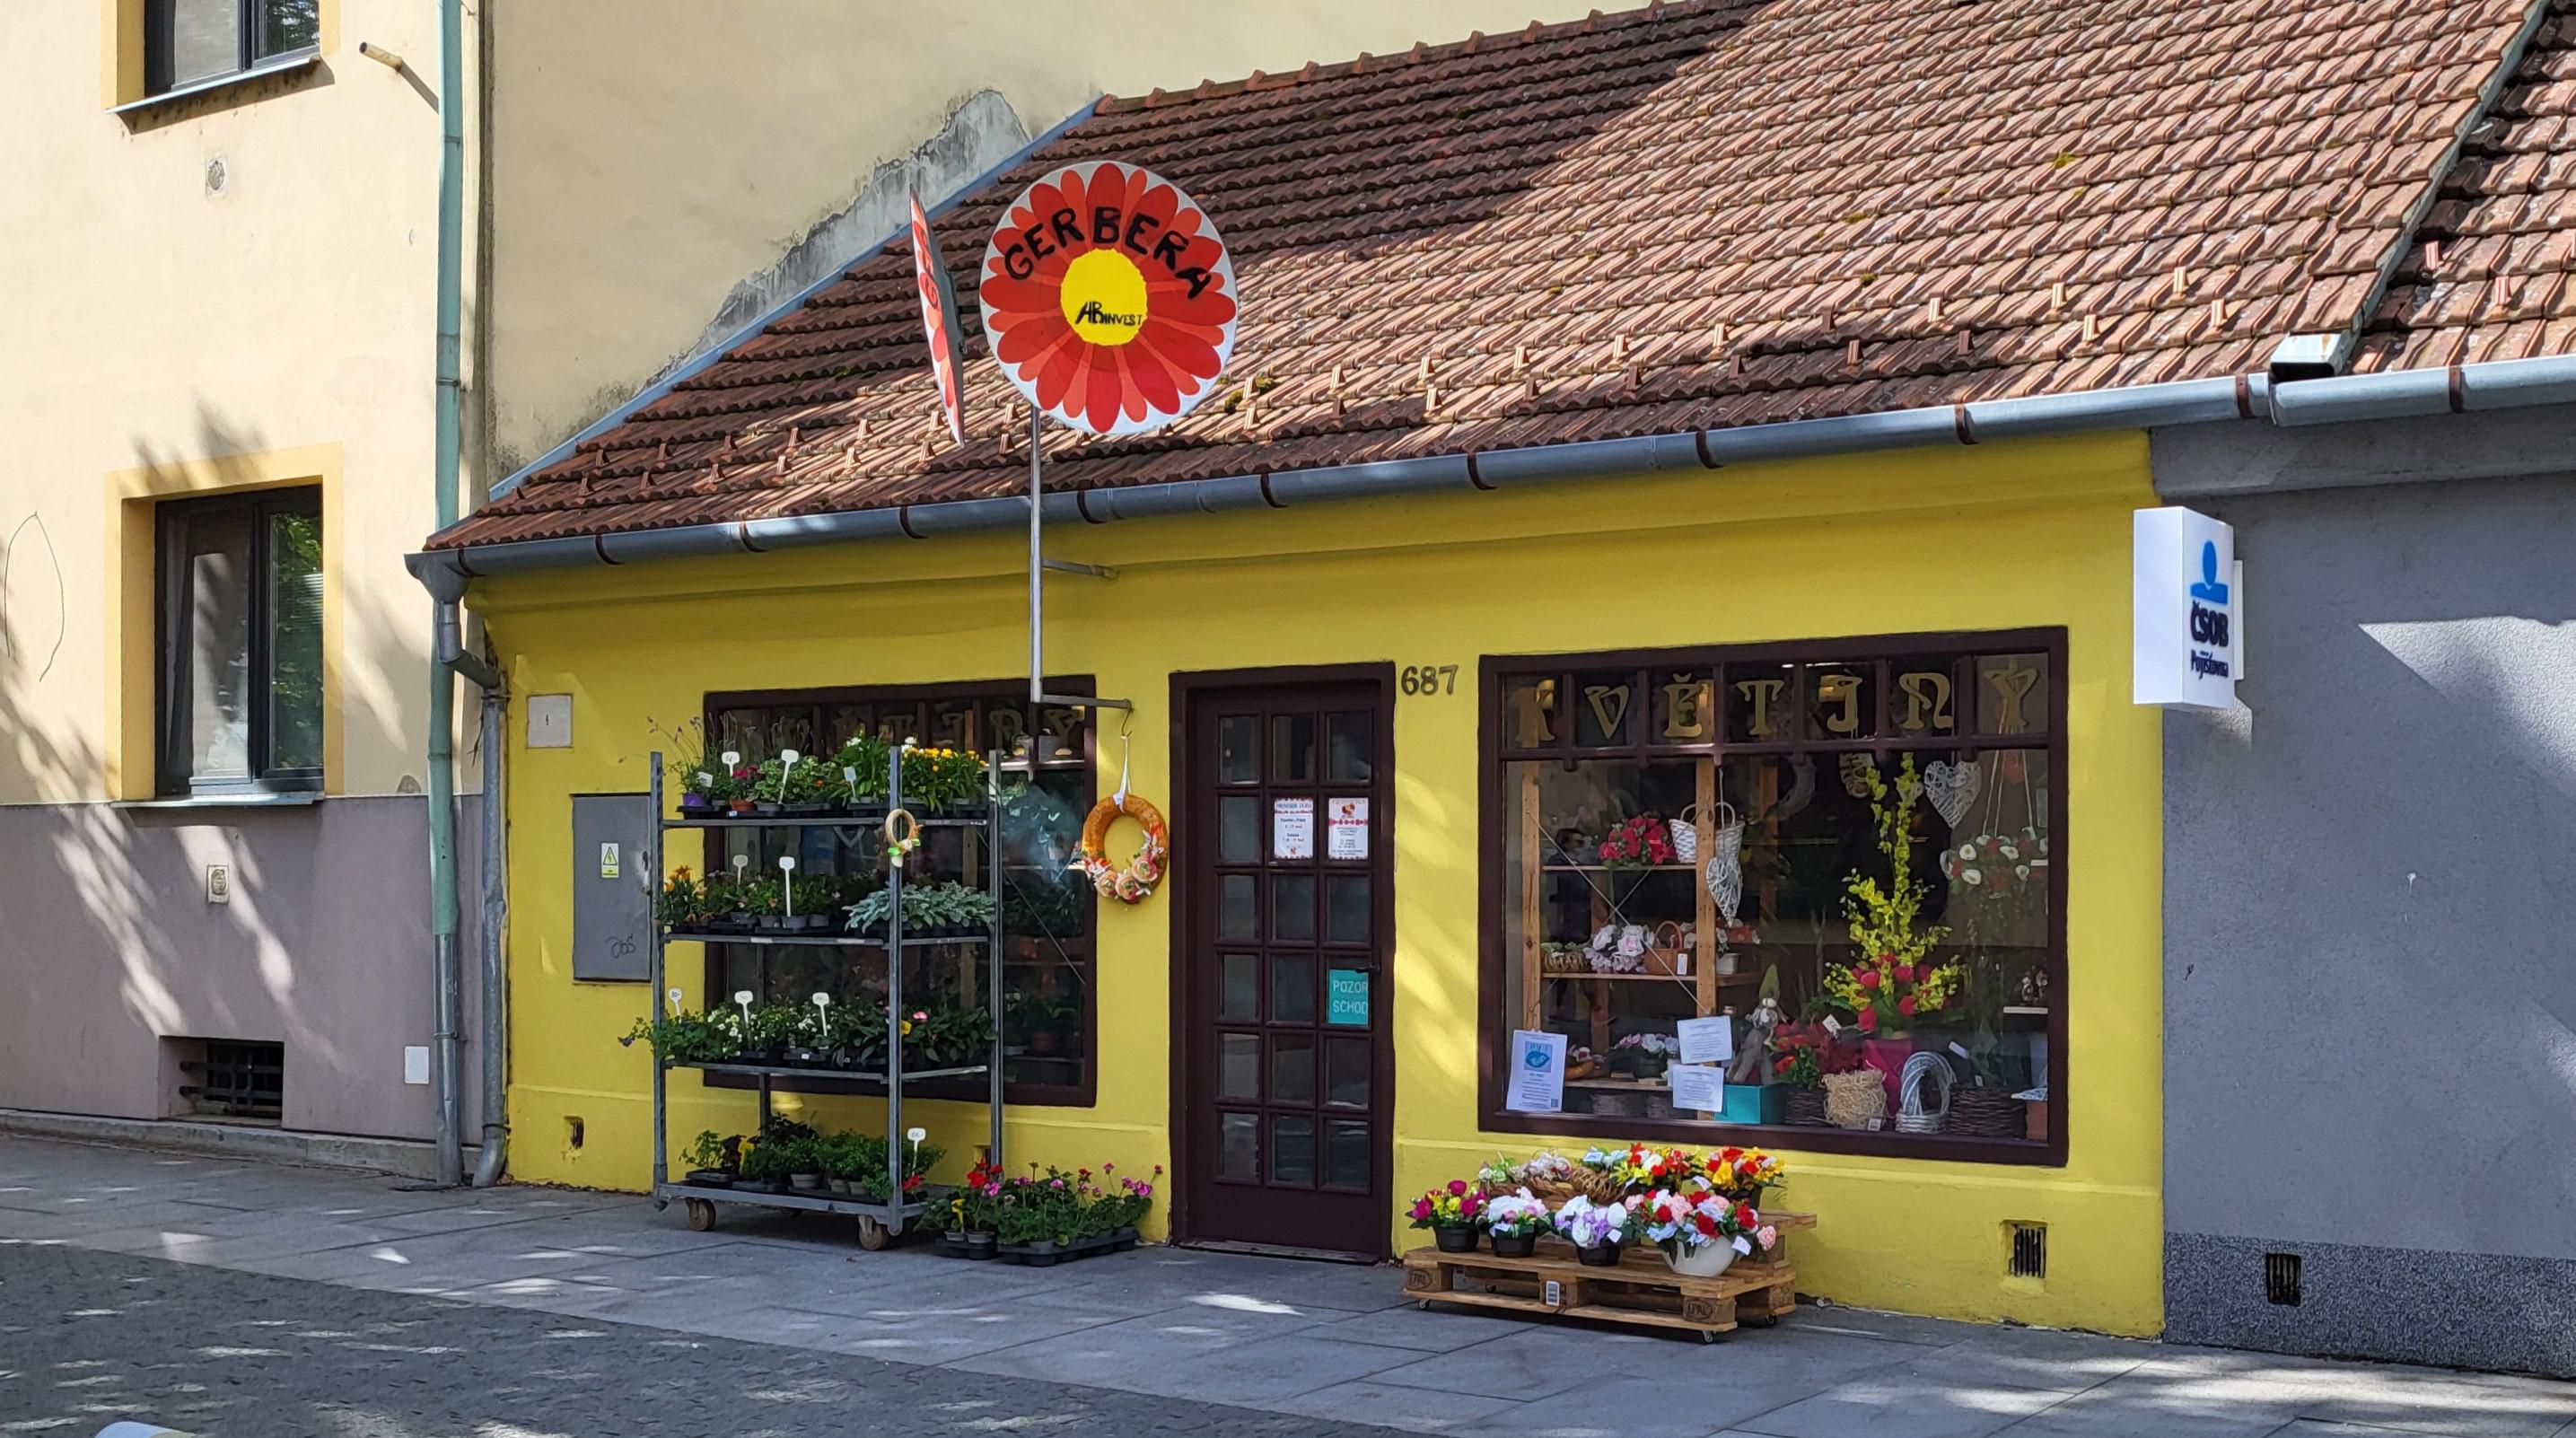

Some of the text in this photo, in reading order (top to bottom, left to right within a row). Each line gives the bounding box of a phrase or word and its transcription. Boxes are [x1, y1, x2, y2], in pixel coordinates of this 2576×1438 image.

[1003, 206, 1211, 300] GERBERA
[2190, 601, 2230, 647] ČSOB
[1401, 664, 1459, 696] 687
[1333, 979, 1368, 994] POZOR
